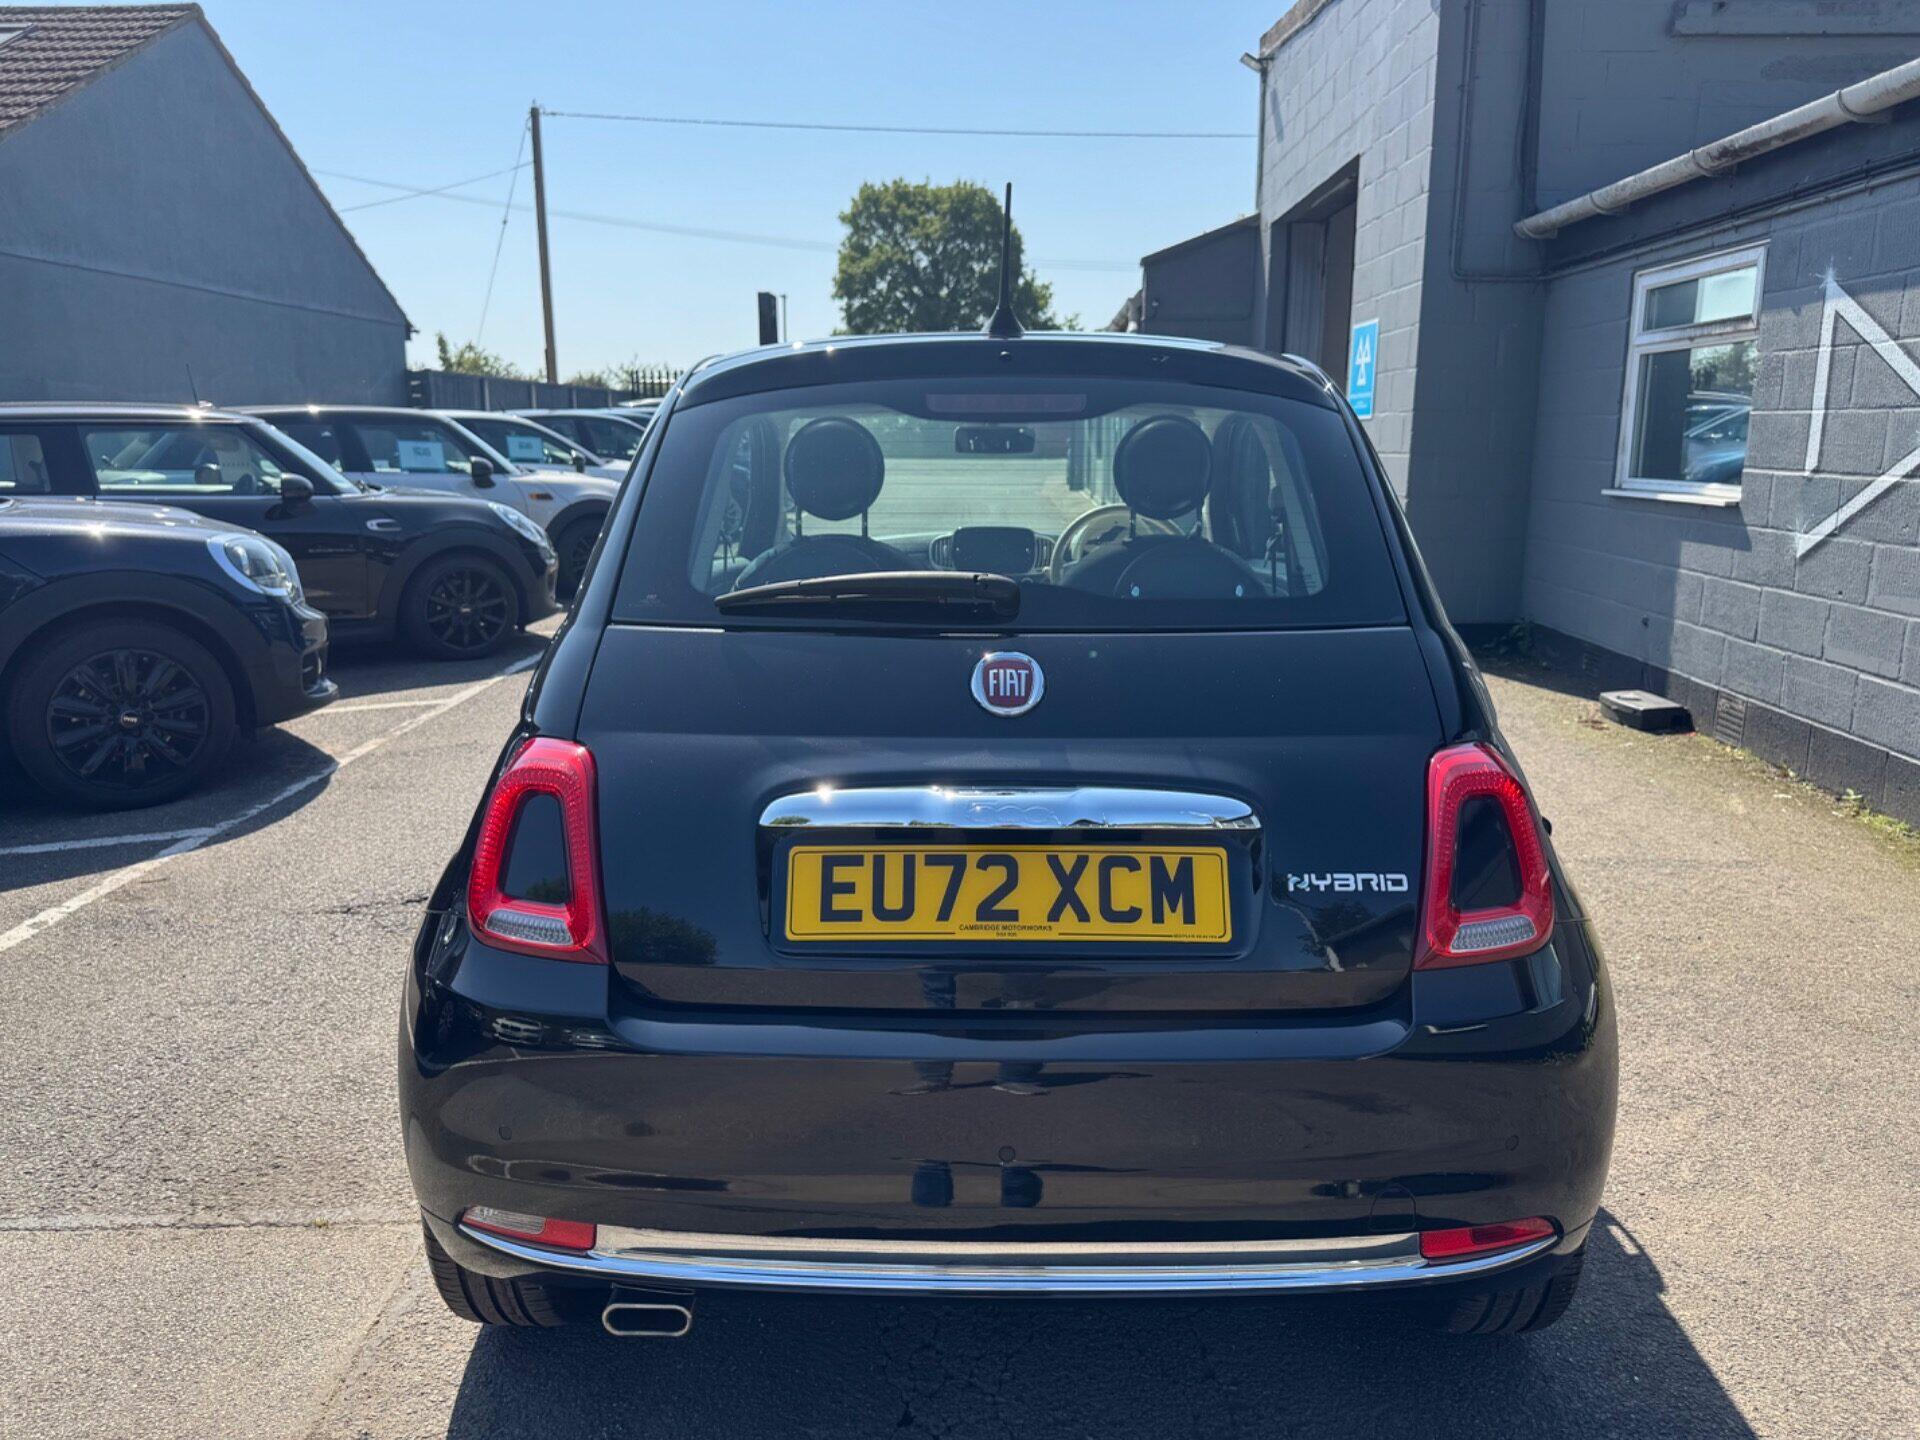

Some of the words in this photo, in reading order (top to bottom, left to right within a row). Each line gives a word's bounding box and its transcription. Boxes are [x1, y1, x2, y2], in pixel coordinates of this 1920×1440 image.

[988, 668, 1029, 697] FIAT
[819, 853, 1019, 923] EU72
[1046, 854, 1196, 925] XCM
[1287, 873, 1409, 892] HYBRID
[1002, 924, 1053, 932] MOTORWORKS
